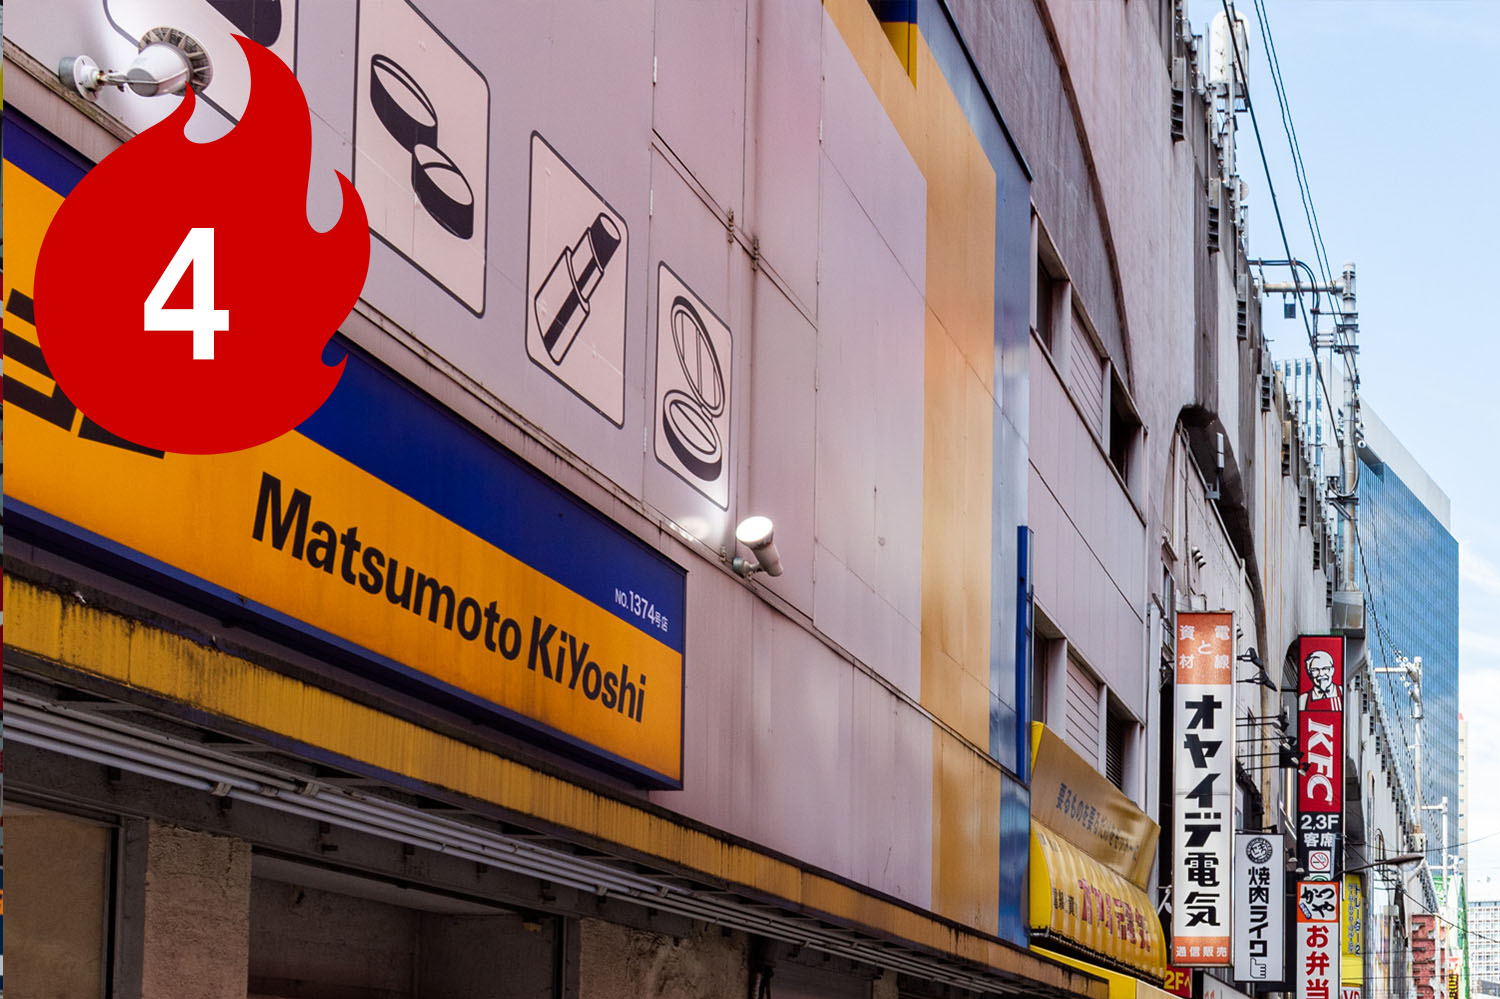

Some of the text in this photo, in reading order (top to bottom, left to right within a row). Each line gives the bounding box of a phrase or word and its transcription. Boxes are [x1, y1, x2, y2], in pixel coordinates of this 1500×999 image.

[252, 472, 521, 660] Matsumoto
[1307, 718, 1333, 803] KFC
[1184, 695, 1222, 927] オヤイデ電気
[1304, 832, 1335, 847] 客席
[1248, 866, 1270, 957] 焼肉ライク
[1301, 886, 1335, 918] かつや
[1176, 946, 1228, 957] 通信販売
